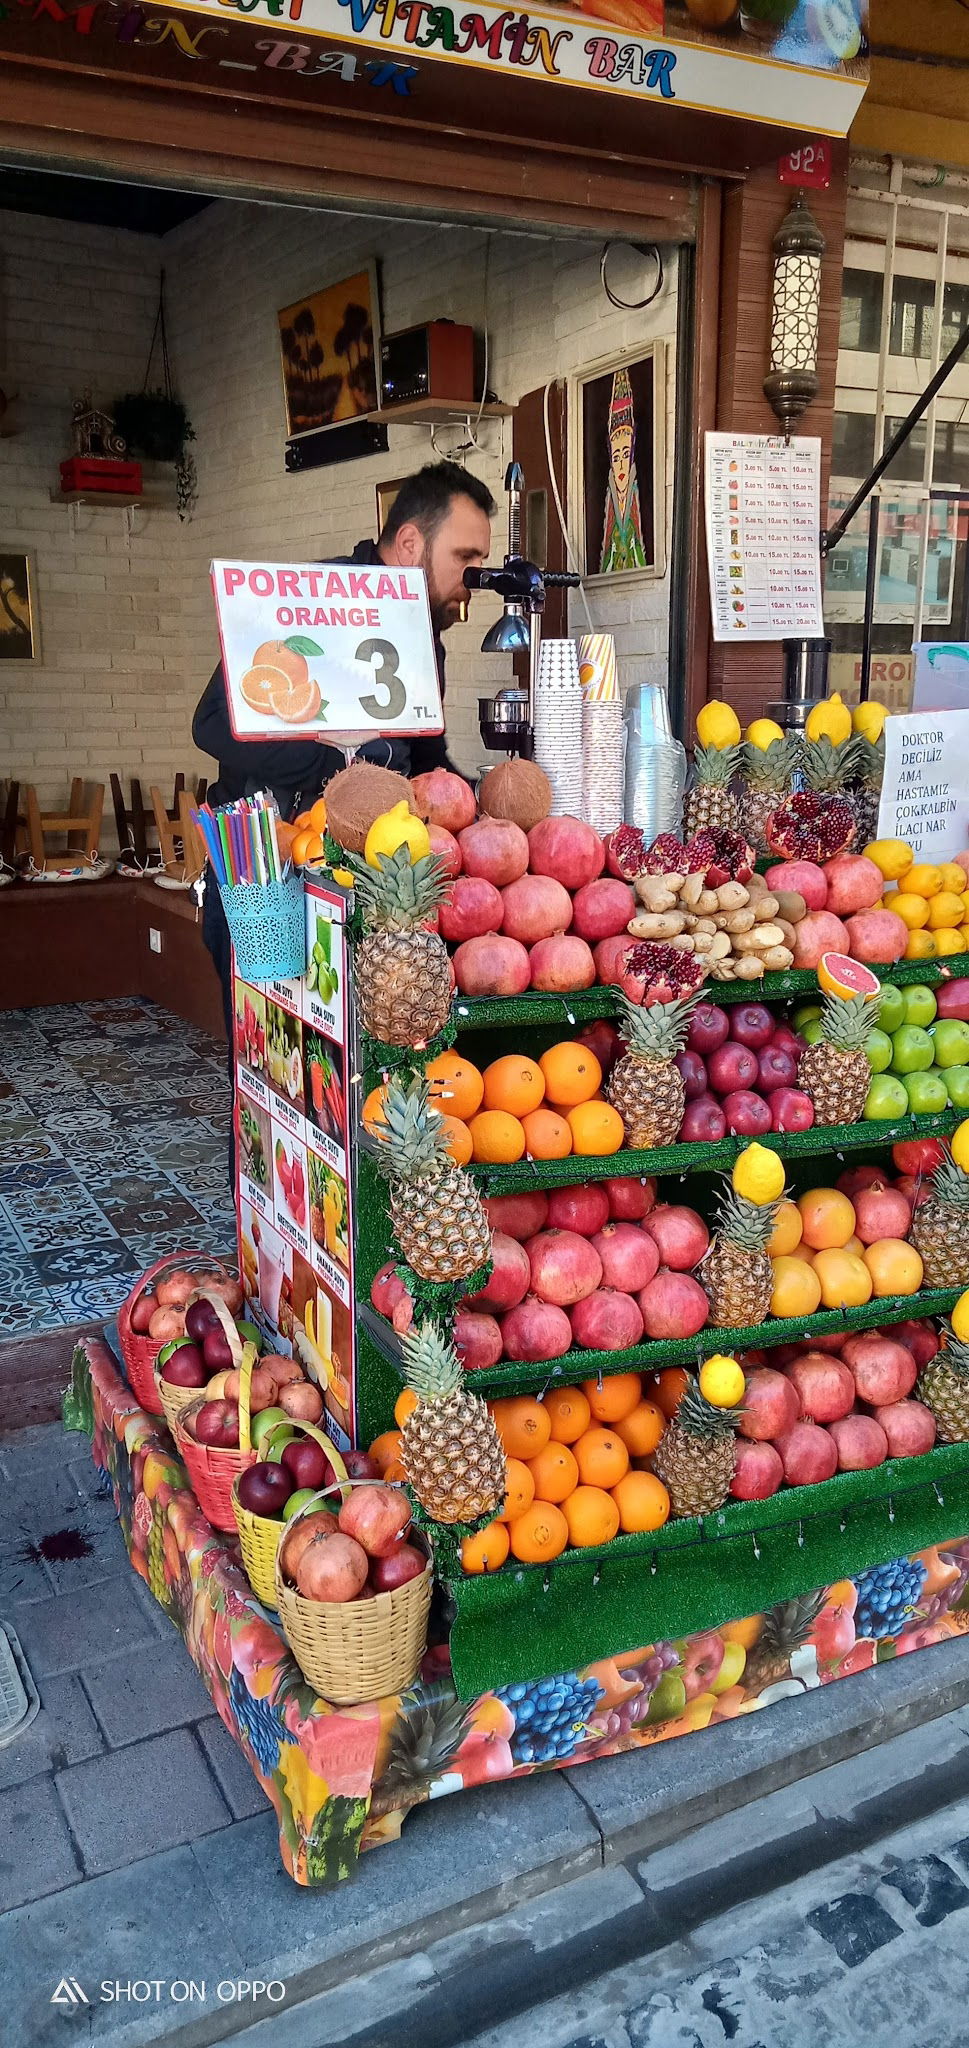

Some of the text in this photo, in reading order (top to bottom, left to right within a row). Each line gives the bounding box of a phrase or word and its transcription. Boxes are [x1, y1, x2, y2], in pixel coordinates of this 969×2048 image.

[584, 37, 677, 98] BAR
[223, 568, 420, 600] PORTAKAL
[276, 607, 381, 627] ORANGE
[355, 638, 437, 720] 3 TL.
[902, 731, 944, 747] DOKTOR
[898, 770, 921, 783] AMA
[896, 783, 949, 801] HASTAMIZ
[895, 819, 946, 836] İLACI NAR
[282, 985, 293, 1000] SUYU
[311, 1002, 335, 1025] ELMA SUYU
[313, 1016, 323, 1028] APPLE
[328, 1140, 339, 1157] SUYU
[297, 1232, 308, 1249] SUYU
[316, 1252, 345, 1290] ANANAS SUYU
